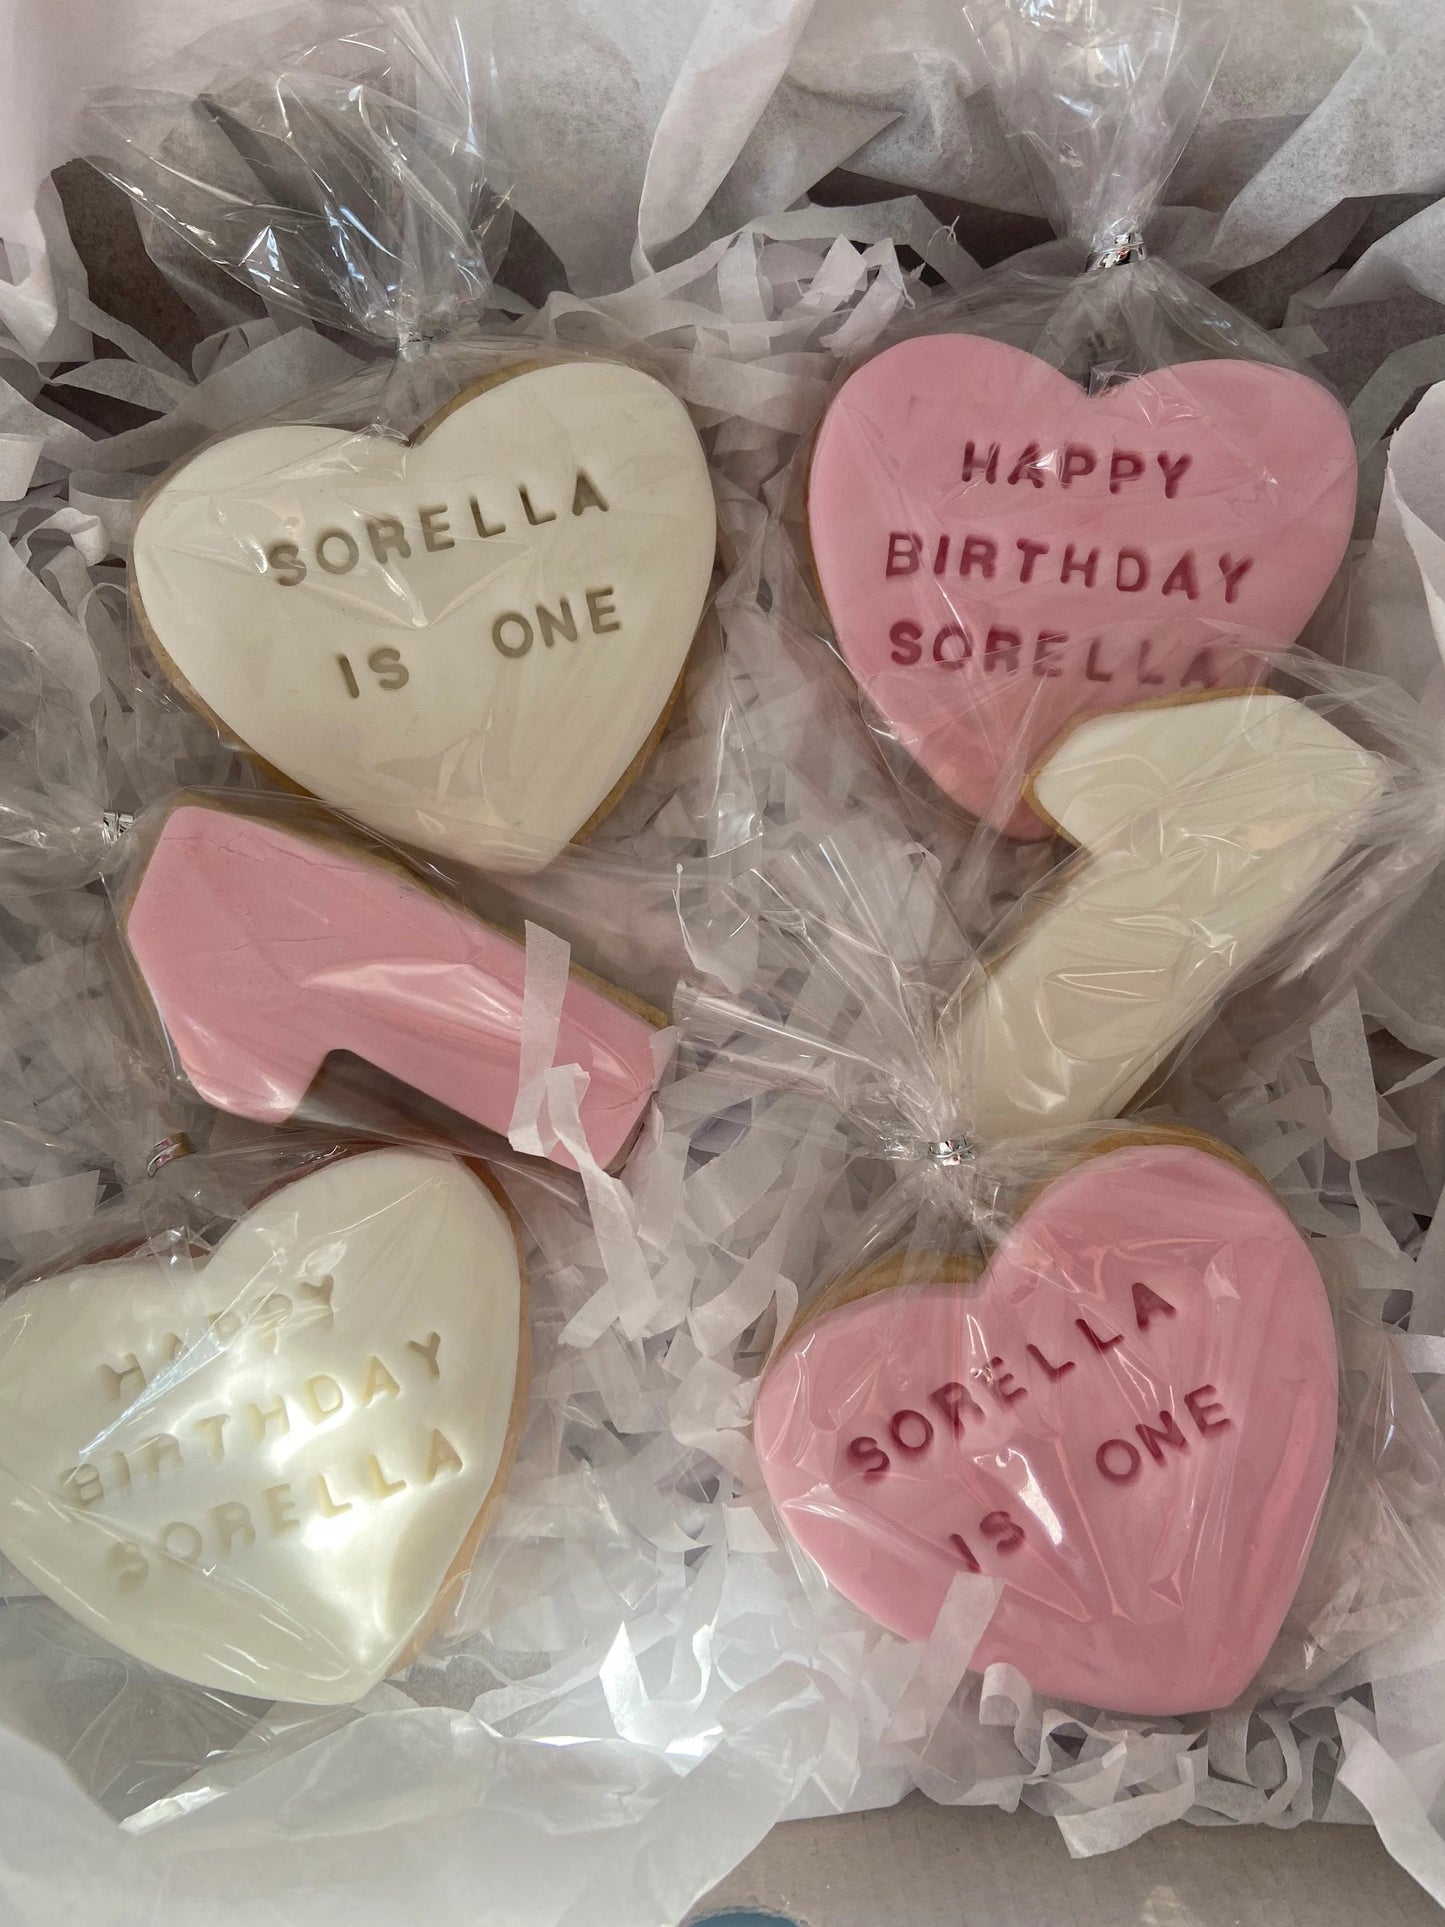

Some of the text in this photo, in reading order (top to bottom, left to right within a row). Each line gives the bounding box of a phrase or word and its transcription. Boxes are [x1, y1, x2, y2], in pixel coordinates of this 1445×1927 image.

[268, 467, 610, 586] SORELLA
[961, 441, 1193, 499] HAPPY
[886, 531, 1254, 603] BIRTHDAY
[337, 585, 621, 698] IS ONE
[889, 618, 1221, 689] SORELLA
[58, 1331, 441, 1507] BIRTHDAY
[846, 1282, 1177, 1484] SORELLA
[106, 1428, 463, 1591] SORELLA
[949, 1384, 1233, 1574] IS ONE
